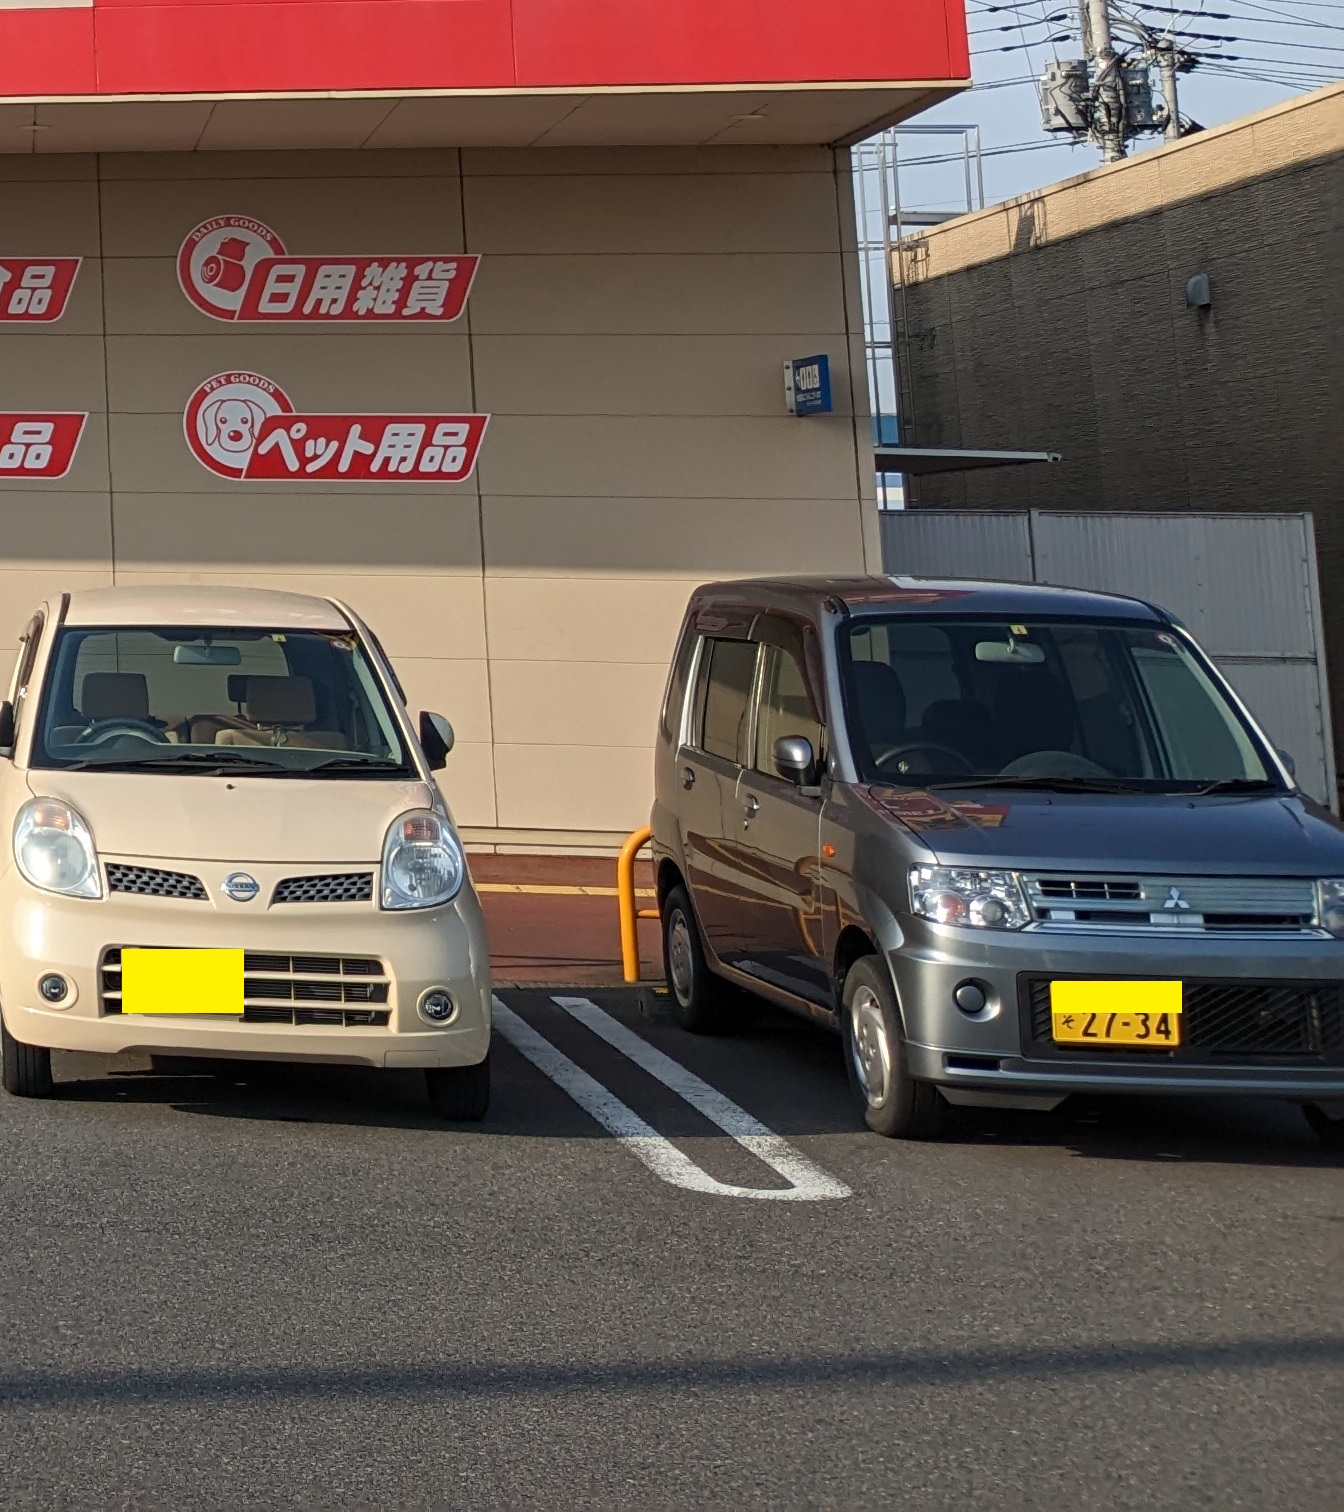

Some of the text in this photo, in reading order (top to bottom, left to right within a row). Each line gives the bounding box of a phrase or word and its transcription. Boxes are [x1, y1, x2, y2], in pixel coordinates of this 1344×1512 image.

[191, 216, 275, 243] DAILY GOODS
[257, 261, 457, 316] 日用雑貨
[203, 374, 276, 394] PET GOODS
[259, 421, 471, 473] ペット用品
[1061, 1013, 1172, 1040] そ 27-34
